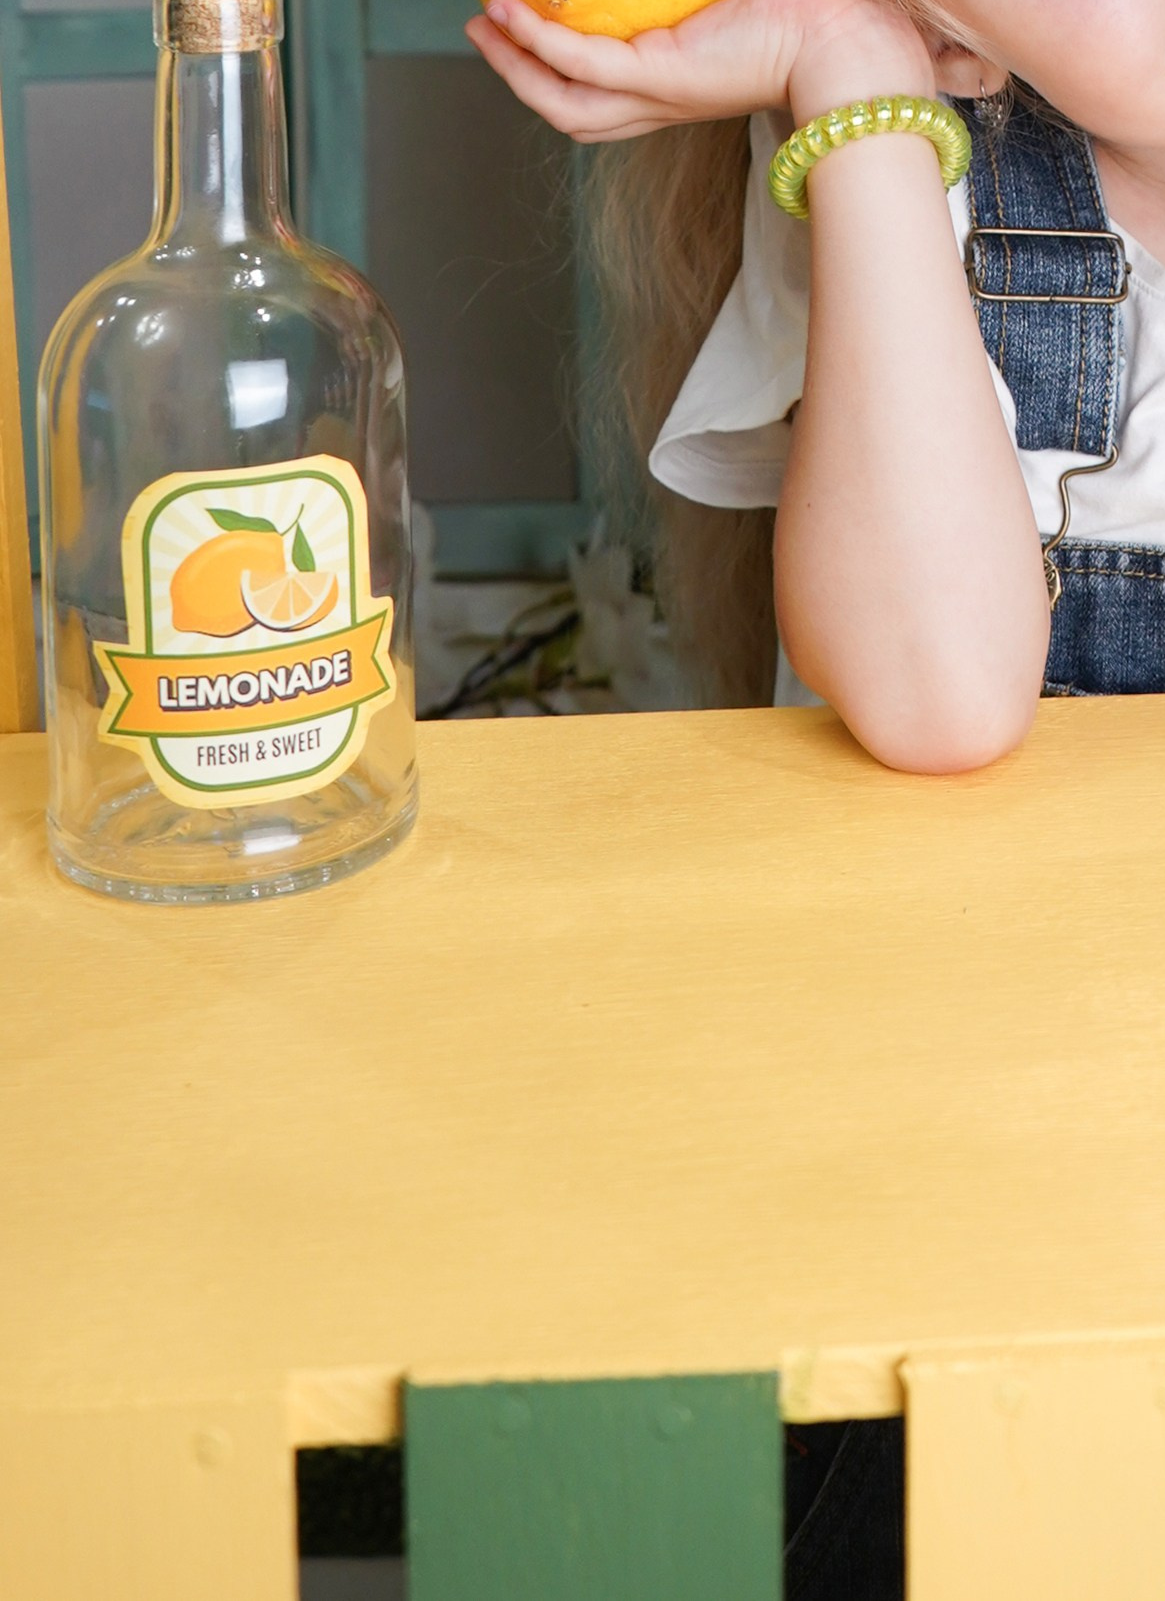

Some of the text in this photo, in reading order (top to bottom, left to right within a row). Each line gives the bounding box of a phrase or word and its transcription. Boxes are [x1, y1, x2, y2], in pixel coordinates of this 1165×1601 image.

[159, 650, 351, 711] LEMONADE
[196, 727, 322, 767] FRESH & SWEET
